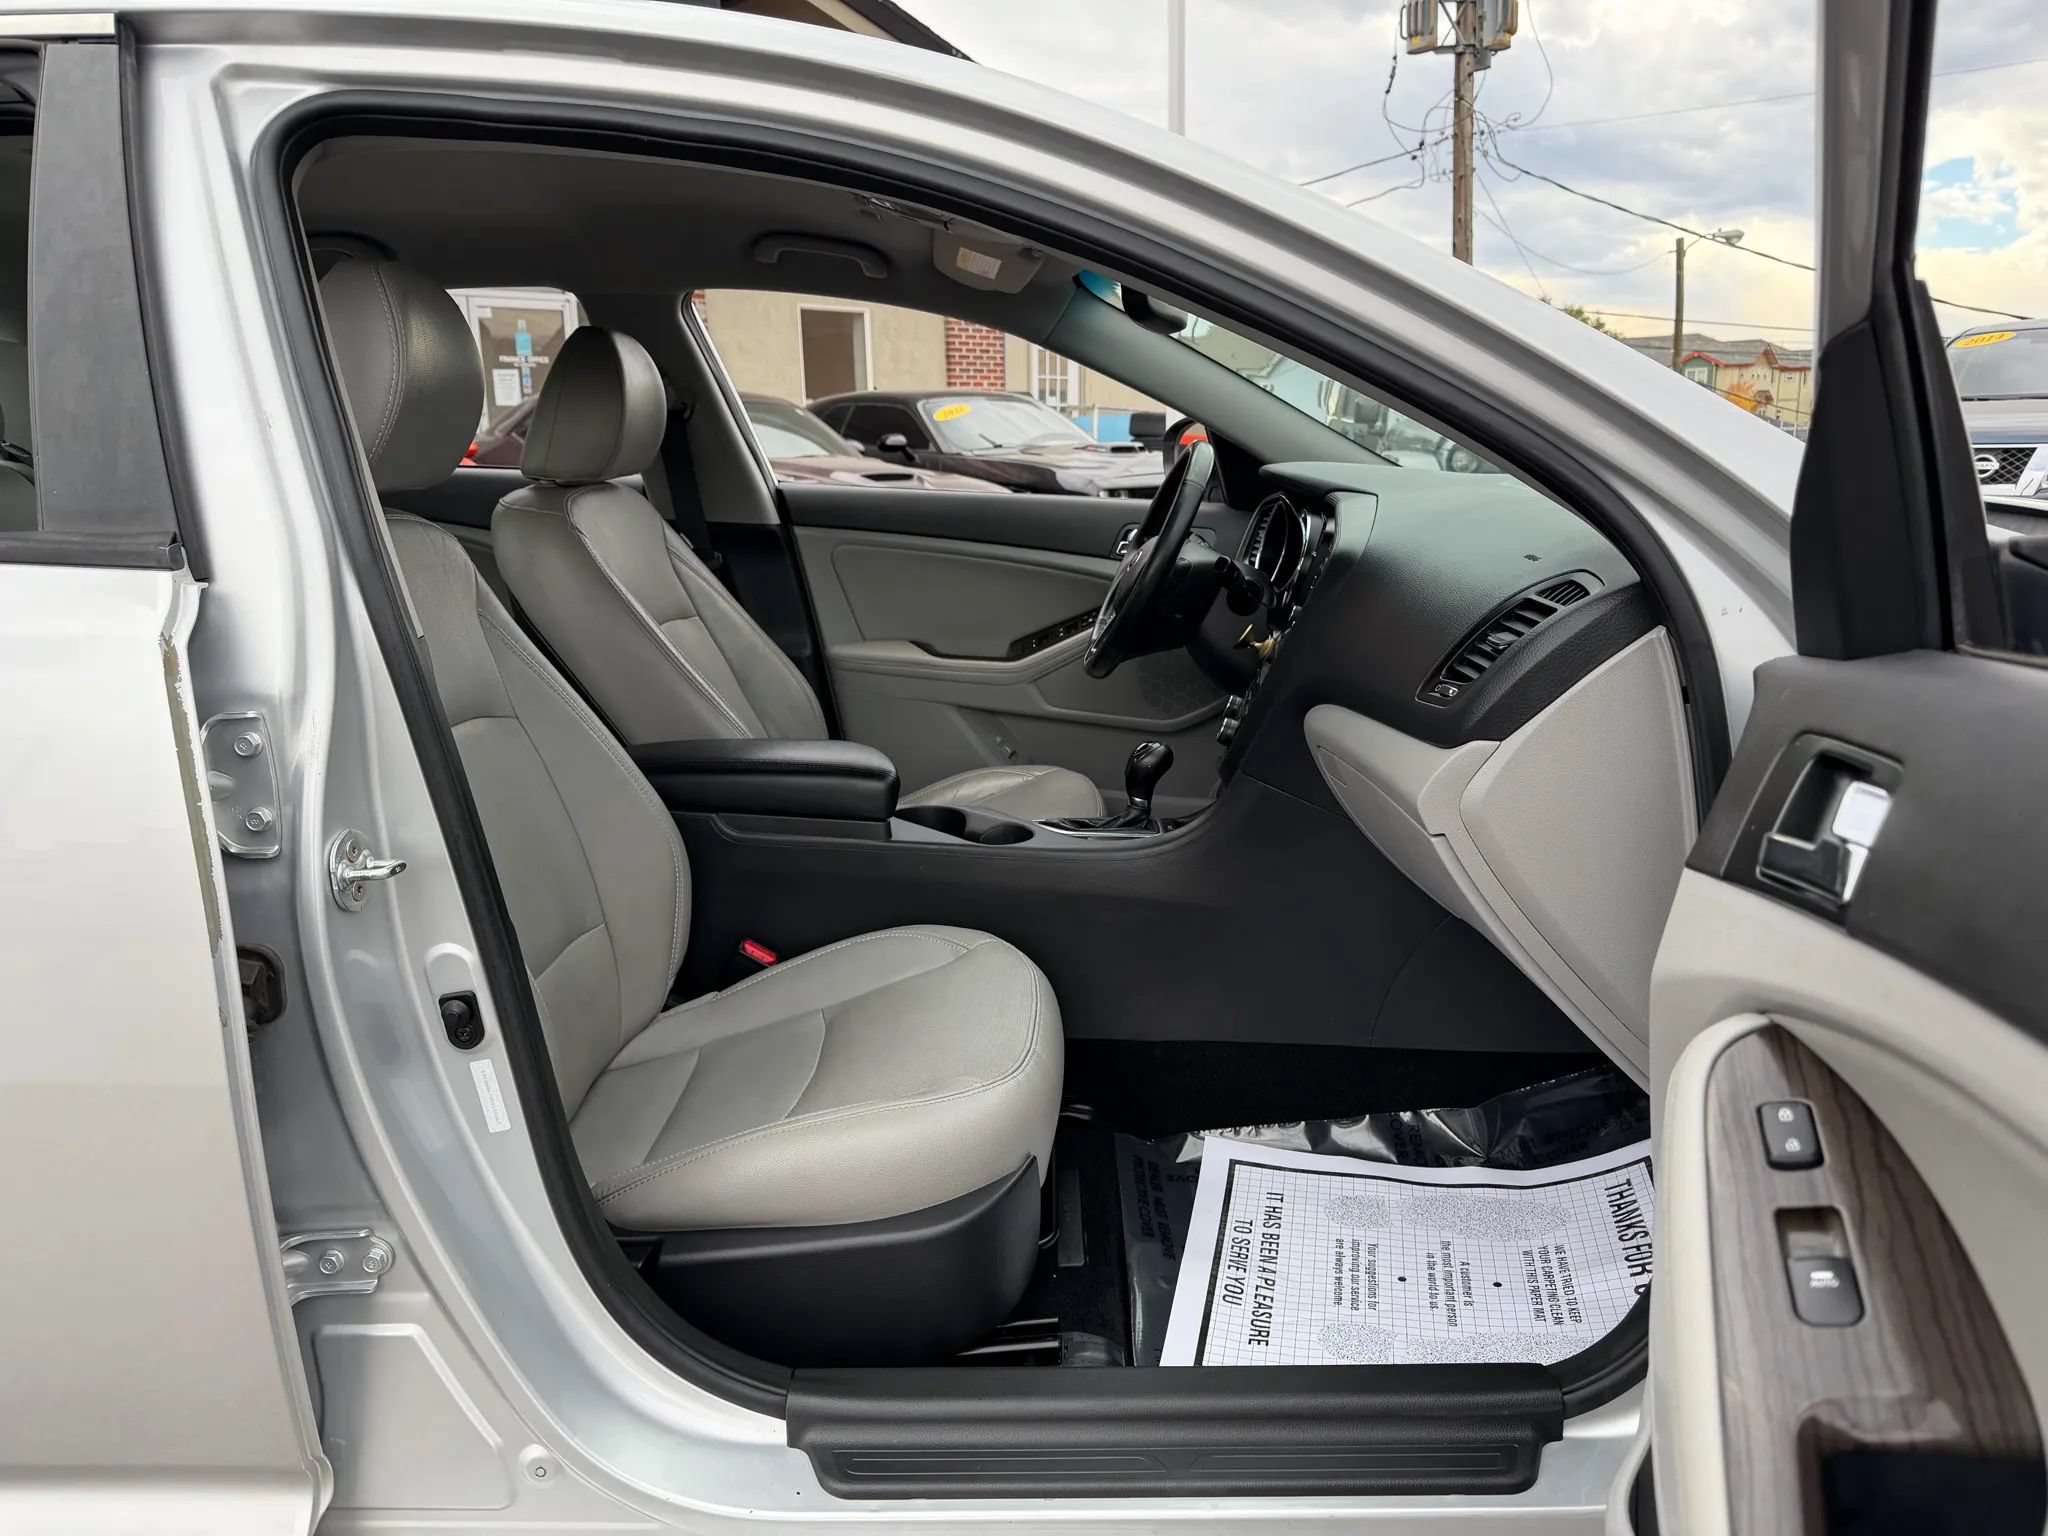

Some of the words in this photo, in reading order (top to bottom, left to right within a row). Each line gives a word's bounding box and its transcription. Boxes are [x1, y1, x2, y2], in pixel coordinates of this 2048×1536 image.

[1265, 1192, 1284, 1203] IT
[1263, 1205, 1283, 1230] HAS
[1604, 1178, 1650, 1242] THANKS
[1233, 1219, 1253, 1234] TO
[1259, 1232, 1281, 1265] BEEN
[1335, 1238, 1344, 1249] are
[1367, 1243, 1379, 1257] Your
[1441, 1240, 1452, 1251] the
[1554, 1244, 1566, 1256] WE
[1227, 1236, 1251, 1273] SERVE
[1332, 1251, 1346, 1275] always
[1348, 1239, 1362, 1273] improving
[1442, 1252, 1454, 1269] most
[1522, 1249, 1535, 1267] WITH
[1537, 1245, 1551, 1265] YOUR
[1622, 1242, 1653, 1277] FOR
[1257, 1265, 1277, 1275] A
[1427, 1260, 1438, 1271] the
[1556, 1256, 1570, 1274] HAVE
[1350, 1274, 1360, 1285] our
[1365, 1260, 1379, 1299] suggestions
[1428, 1272, 1440, 1292] world
[1443, 1270, 1457, 1302] important
[1460, 1267, 1473, 1298] customer
[1525, 1268, 1539, 1284] THIS
[1541, 1265, 1560, 1303] CARPETING
[1560, 1274, 1575, 1296] TRIED
[1222, 1275, 1246, 1306] YOU
[1350, 1286, 1362, 1311] service
[1429, 1292, 1440, 1300] to
[1528, 1285, 1543, 1306] PAPER
[1367, 1300, 1380, 1311] for
[1565, 1296, 1578, 1306] TO
[1248, 1276, 1276, 1347] PLEASURE
[1444, 1302, 1458, 1327] person
[1532, 1307, 1547, 1323] MAT
[1549, 1304, 1565, 1326] CLEAN
[1568, 1307, 1582, 1324] KEEP
